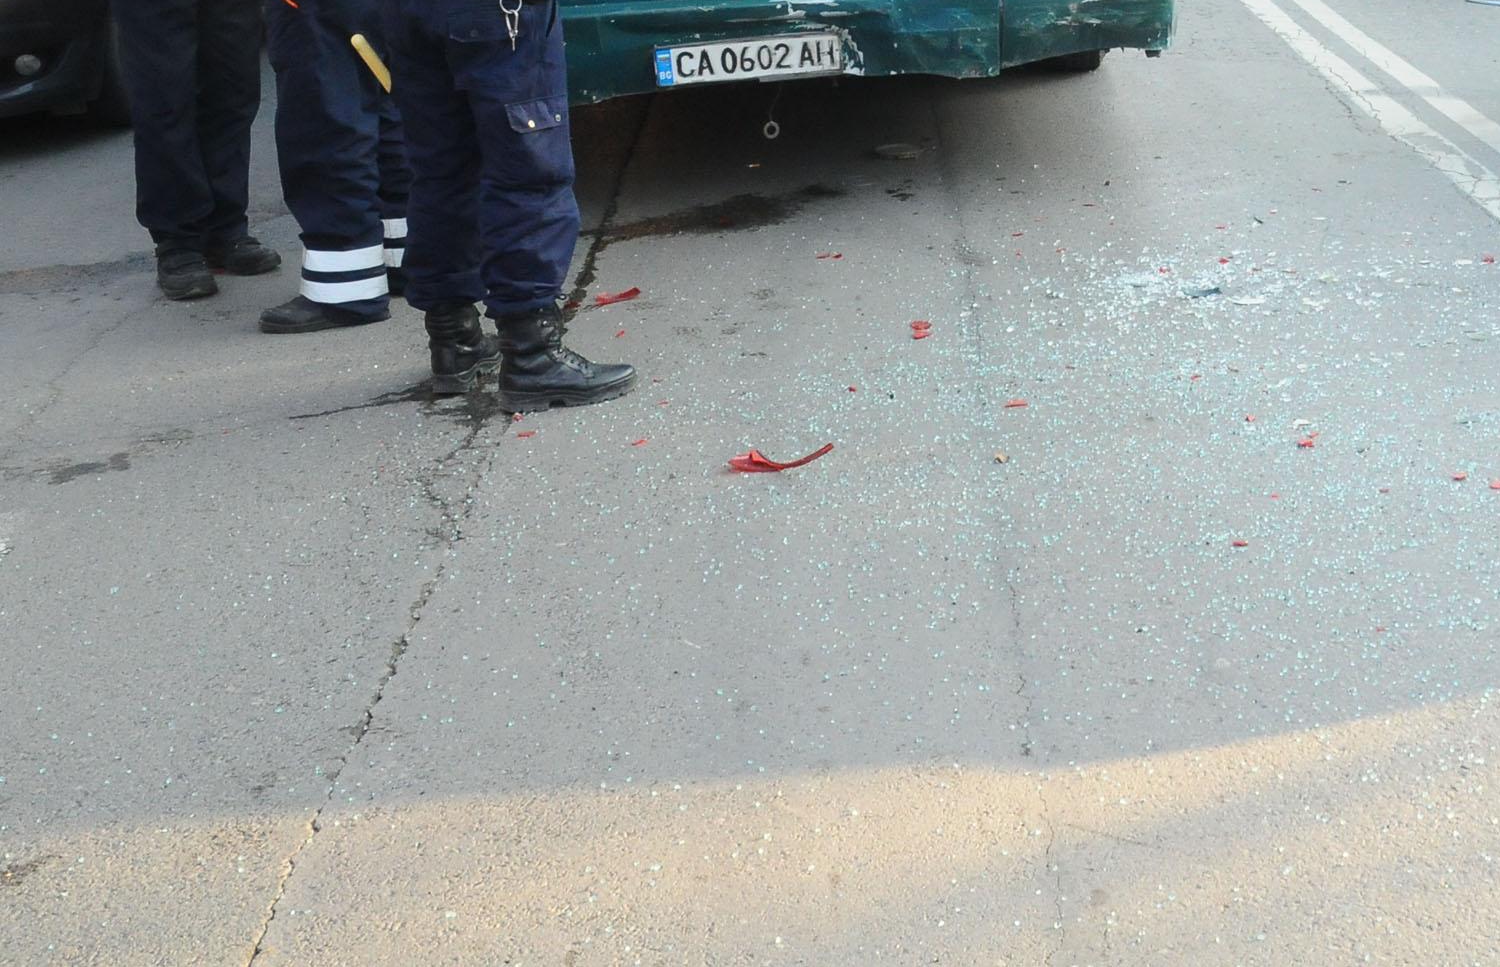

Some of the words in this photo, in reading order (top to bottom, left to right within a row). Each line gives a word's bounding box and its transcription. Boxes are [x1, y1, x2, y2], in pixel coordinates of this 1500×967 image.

[676, 48, 715, 78] CA
[720, 42, 791, 74] 0602
[799, 41, 835, 68] AH
[659, 70, 672, 80] BG
